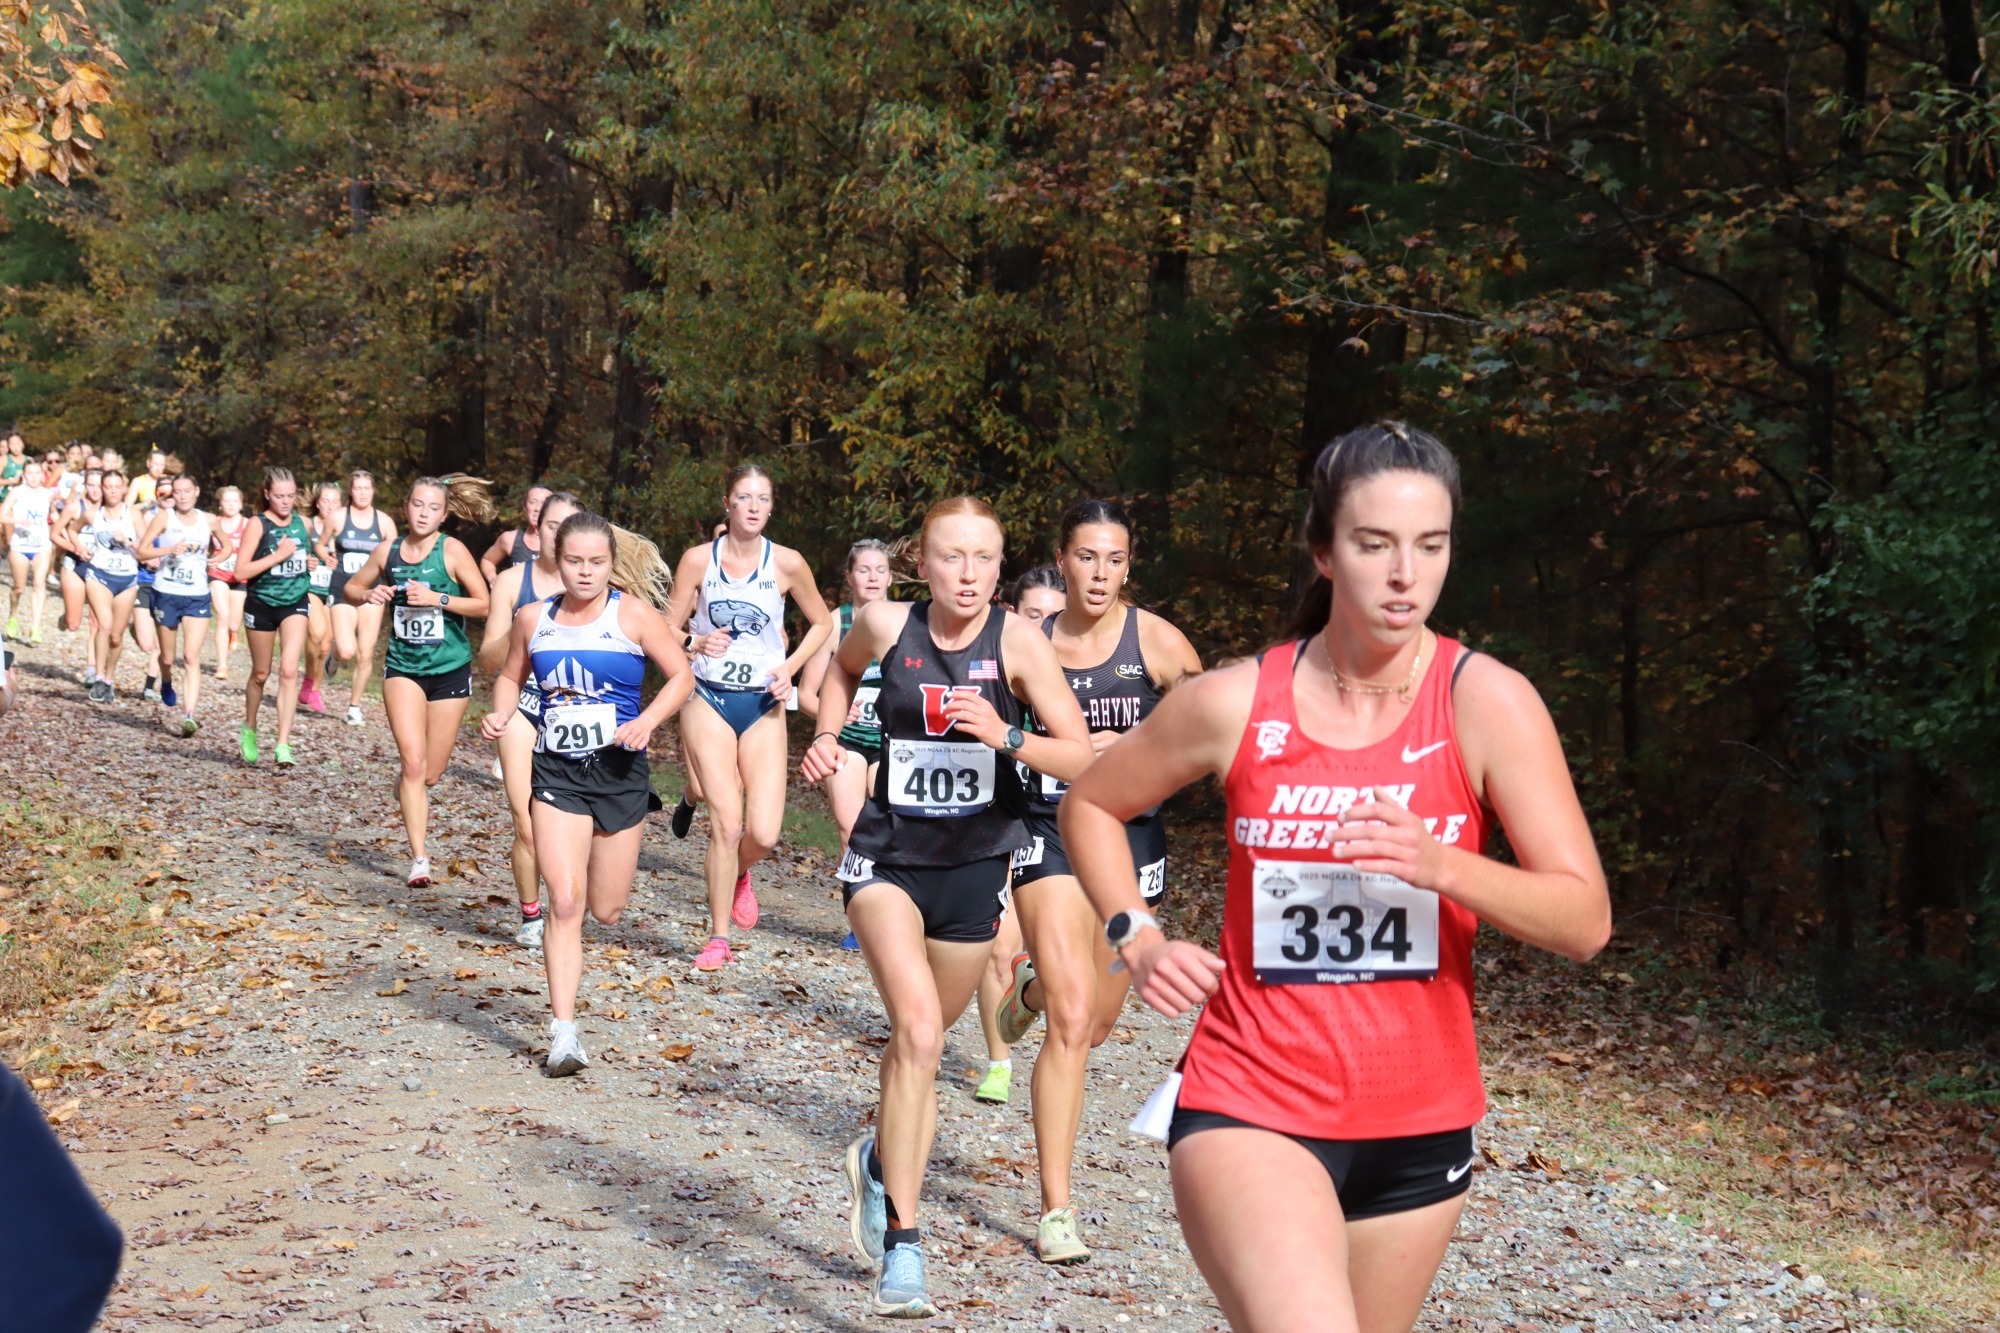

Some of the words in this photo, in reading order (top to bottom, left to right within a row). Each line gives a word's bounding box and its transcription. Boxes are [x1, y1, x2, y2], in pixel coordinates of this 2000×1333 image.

[107, 558, 122, 568] 23
[280, 560, 302, 573] 193
[169, 567, 193, 580] 154
[759, 580, 775, 590] PBC
[401, 619, 435, 637] 192
[538, 629, 555, 638] SAC
[721, 661, 752, 684] 28
[1119, 664, 1143, 675] SAC
[554, 722, 603, 750] 291
[904, 767, 979, 803] 403
[1322, 873, 1348, 881] NCAA
[1365, 874, 1378, 882] XC
[1281, 904, 1413, 963] 334
[1316, 972, 1358, 982] Wingate,
[1359, 972, 1375, 981] NC
